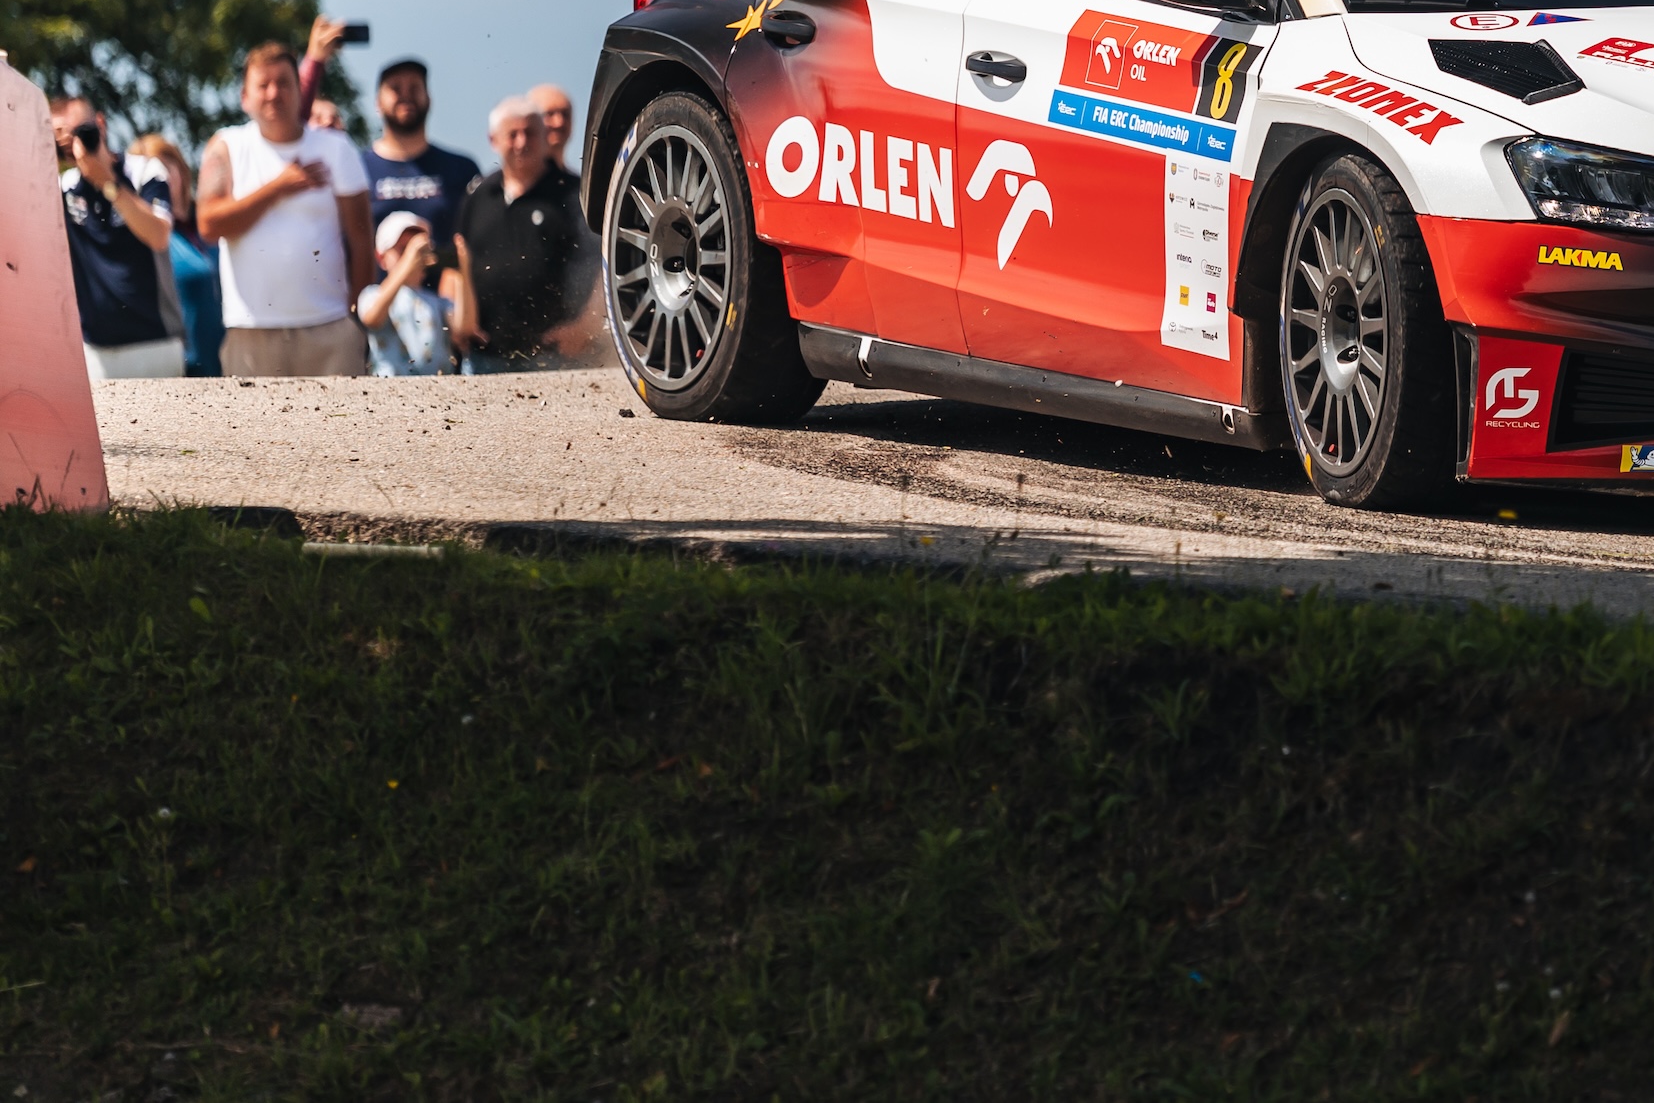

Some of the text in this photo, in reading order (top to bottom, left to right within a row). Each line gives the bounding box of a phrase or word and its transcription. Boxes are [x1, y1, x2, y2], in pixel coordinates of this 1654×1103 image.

[1132, 39, 1182, 66] ORLEN
[1130, 64, 1147, 81] OIL
[1210, 43, 1248, 120] 8
[1092, 106, 1190, 146] FIA ERC Championship
[765, 115, 956, 229] ORLEN
[1538, 246, 1623, 270] LAKMA
[1485, 420, 1541, 429] RECYCLING
